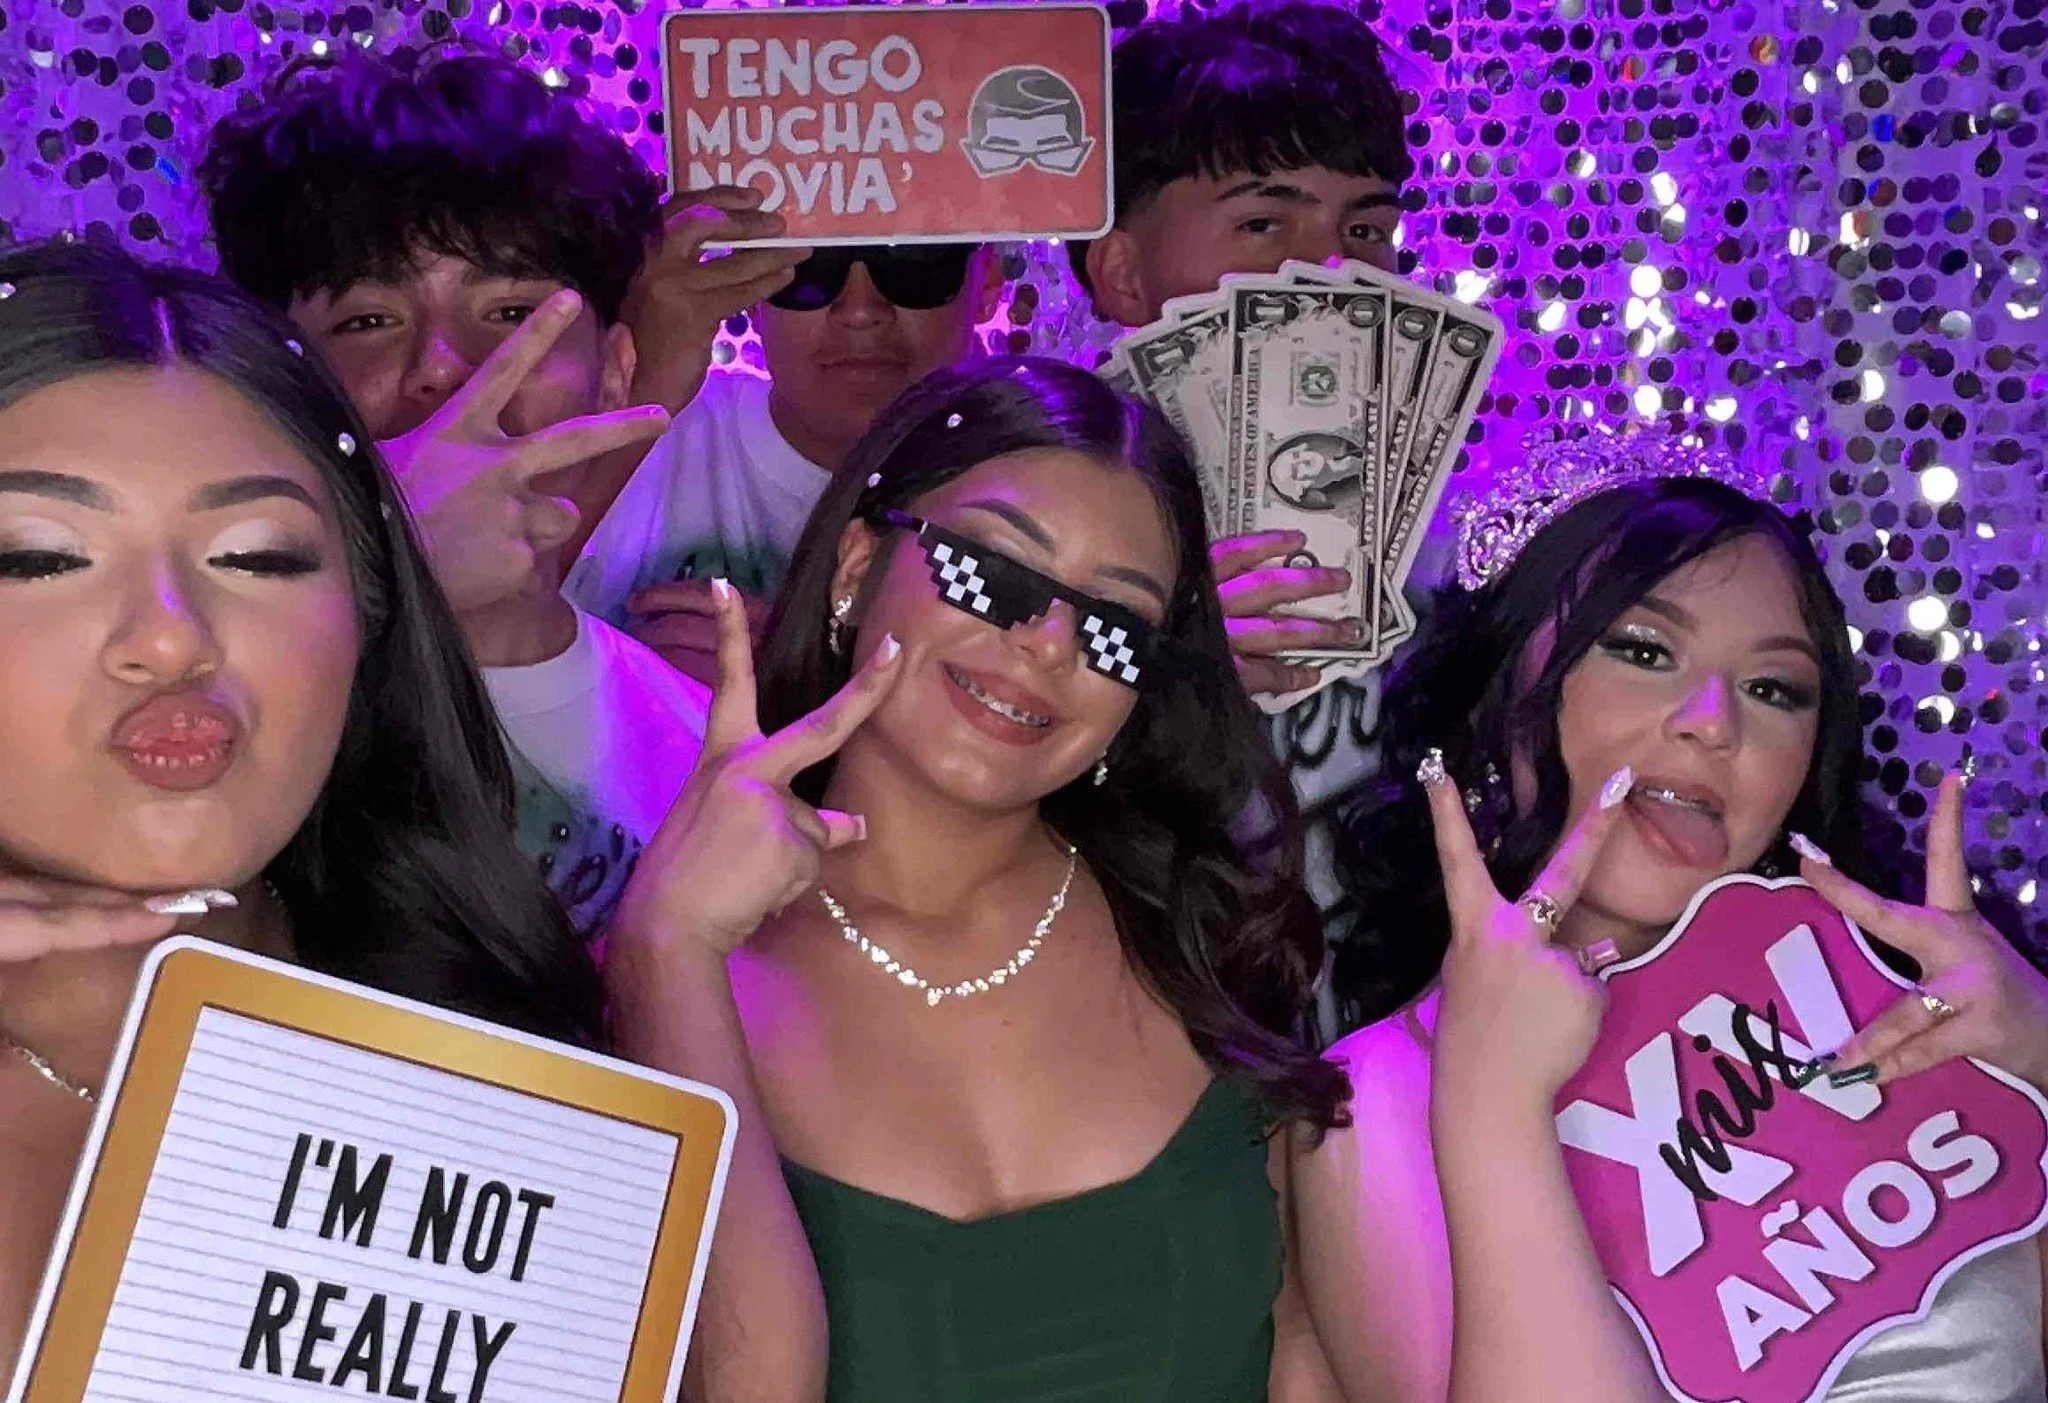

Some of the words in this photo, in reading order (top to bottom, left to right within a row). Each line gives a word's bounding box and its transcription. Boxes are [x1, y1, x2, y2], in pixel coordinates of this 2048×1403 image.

[680, 35, 922, 98] TENGO
[686, 100, 944, 156] MUCHAS
[1554, 923, 1883, 1278] XV
[273, 1132, 393, 1247] I'M
[407, 1166, 555, 1282] NOT
[1716, 1110, 2001, 1372] AÑOS
[239, 1270, 517, 1403] REALLY
